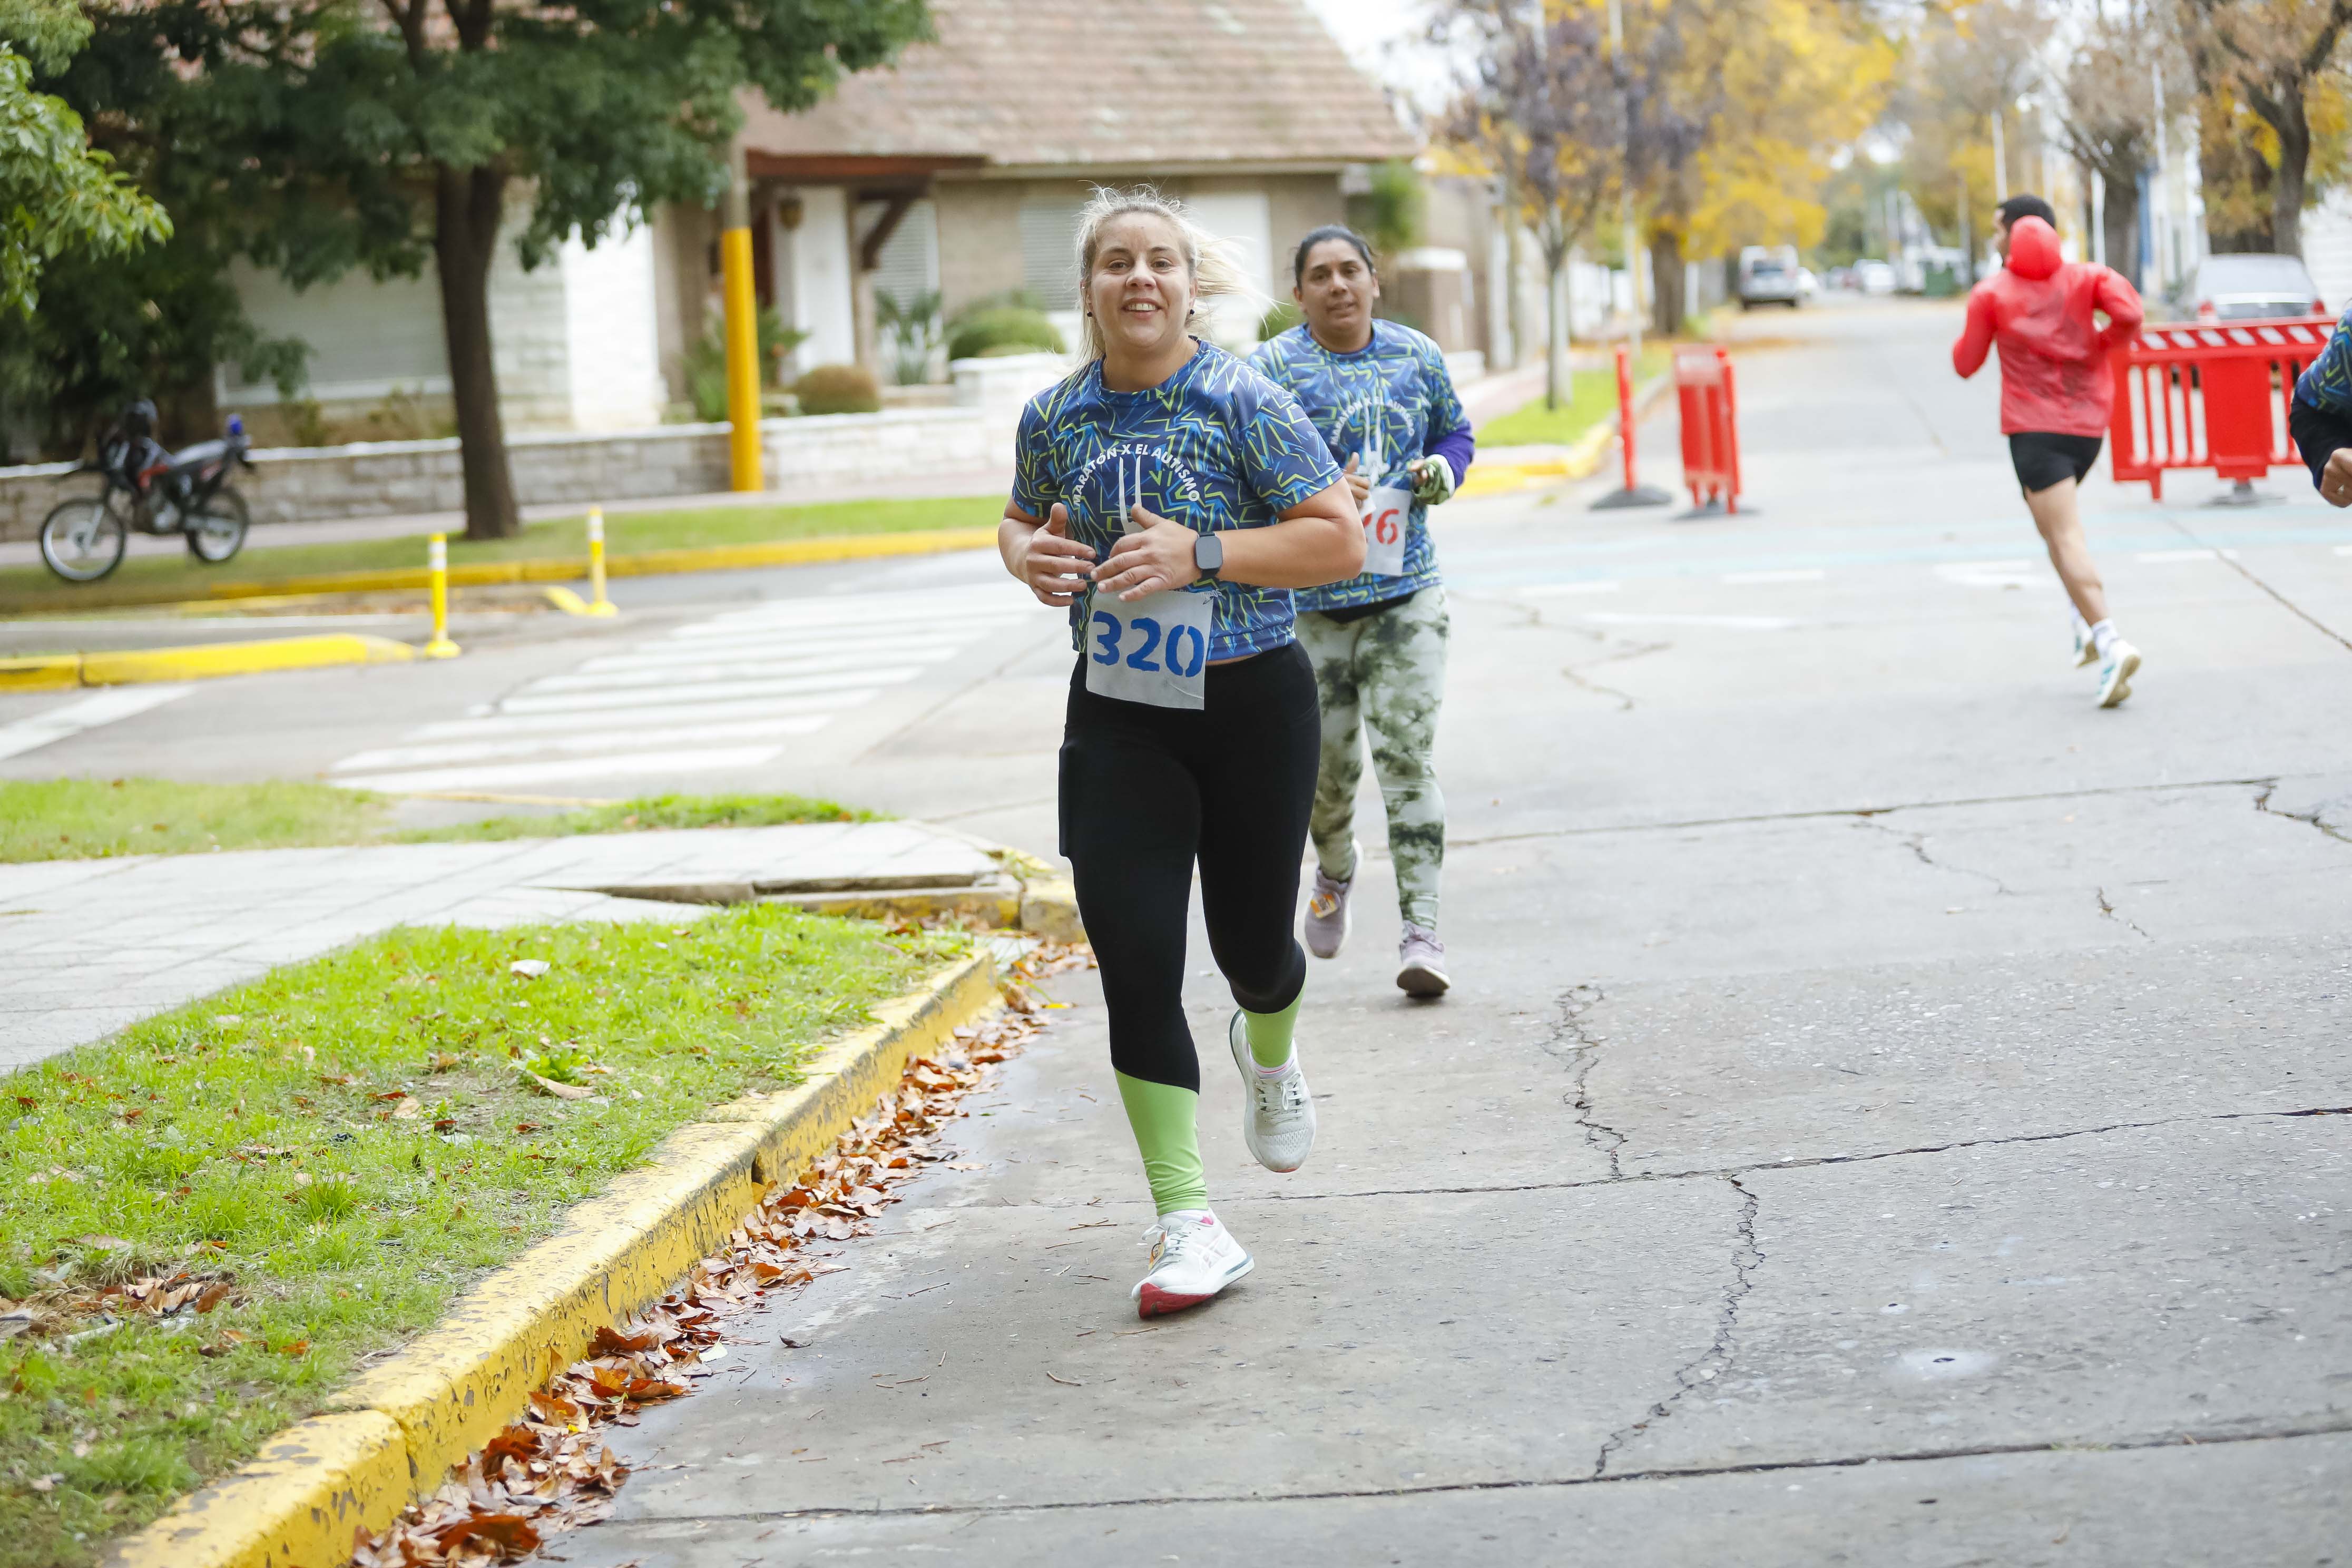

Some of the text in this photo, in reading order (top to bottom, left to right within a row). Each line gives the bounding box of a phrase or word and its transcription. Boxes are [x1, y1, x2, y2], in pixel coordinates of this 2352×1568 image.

[1073, 444, 1200, 506] MARATÓN X EL AUTISMO
[1093, 610, 1204, 678] 320
